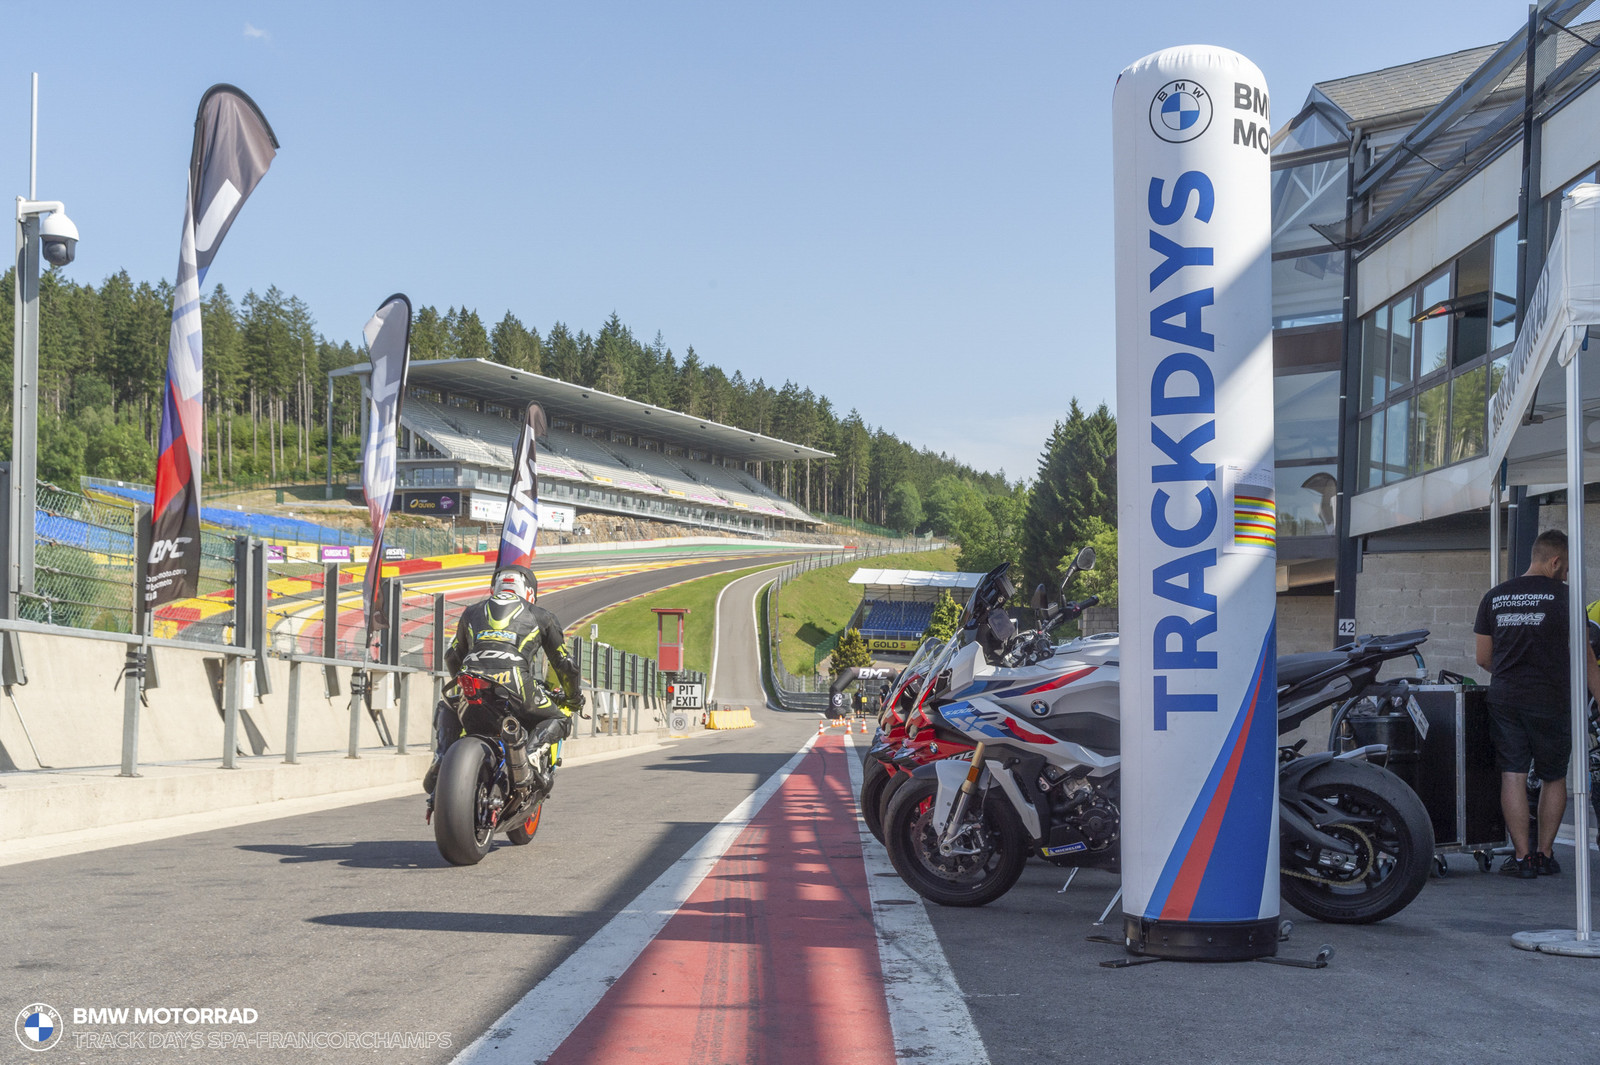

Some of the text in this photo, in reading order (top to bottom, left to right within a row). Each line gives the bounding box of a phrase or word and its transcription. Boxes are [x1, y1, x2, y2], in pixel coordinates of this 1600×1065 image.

[1157, 82, 1205, 103] BMW
[1234, 82, 1271, 125] BM
[1233, 118, 1271, 155] MO
[1148, 170, 1218, 731] TRACKDAYS
[147, 536, 193, 564] BMC
[1492, 593, 1555, 604] BMW MOTORRAD
[1492, 600, 1540, 611] MOTORSPORT
[1339, 621, 1355, 633] 42
[857, 668, 890, 680] BMC
[679, 685, 695, 695] PIT
[675, 696, 698, 707] EXIT
